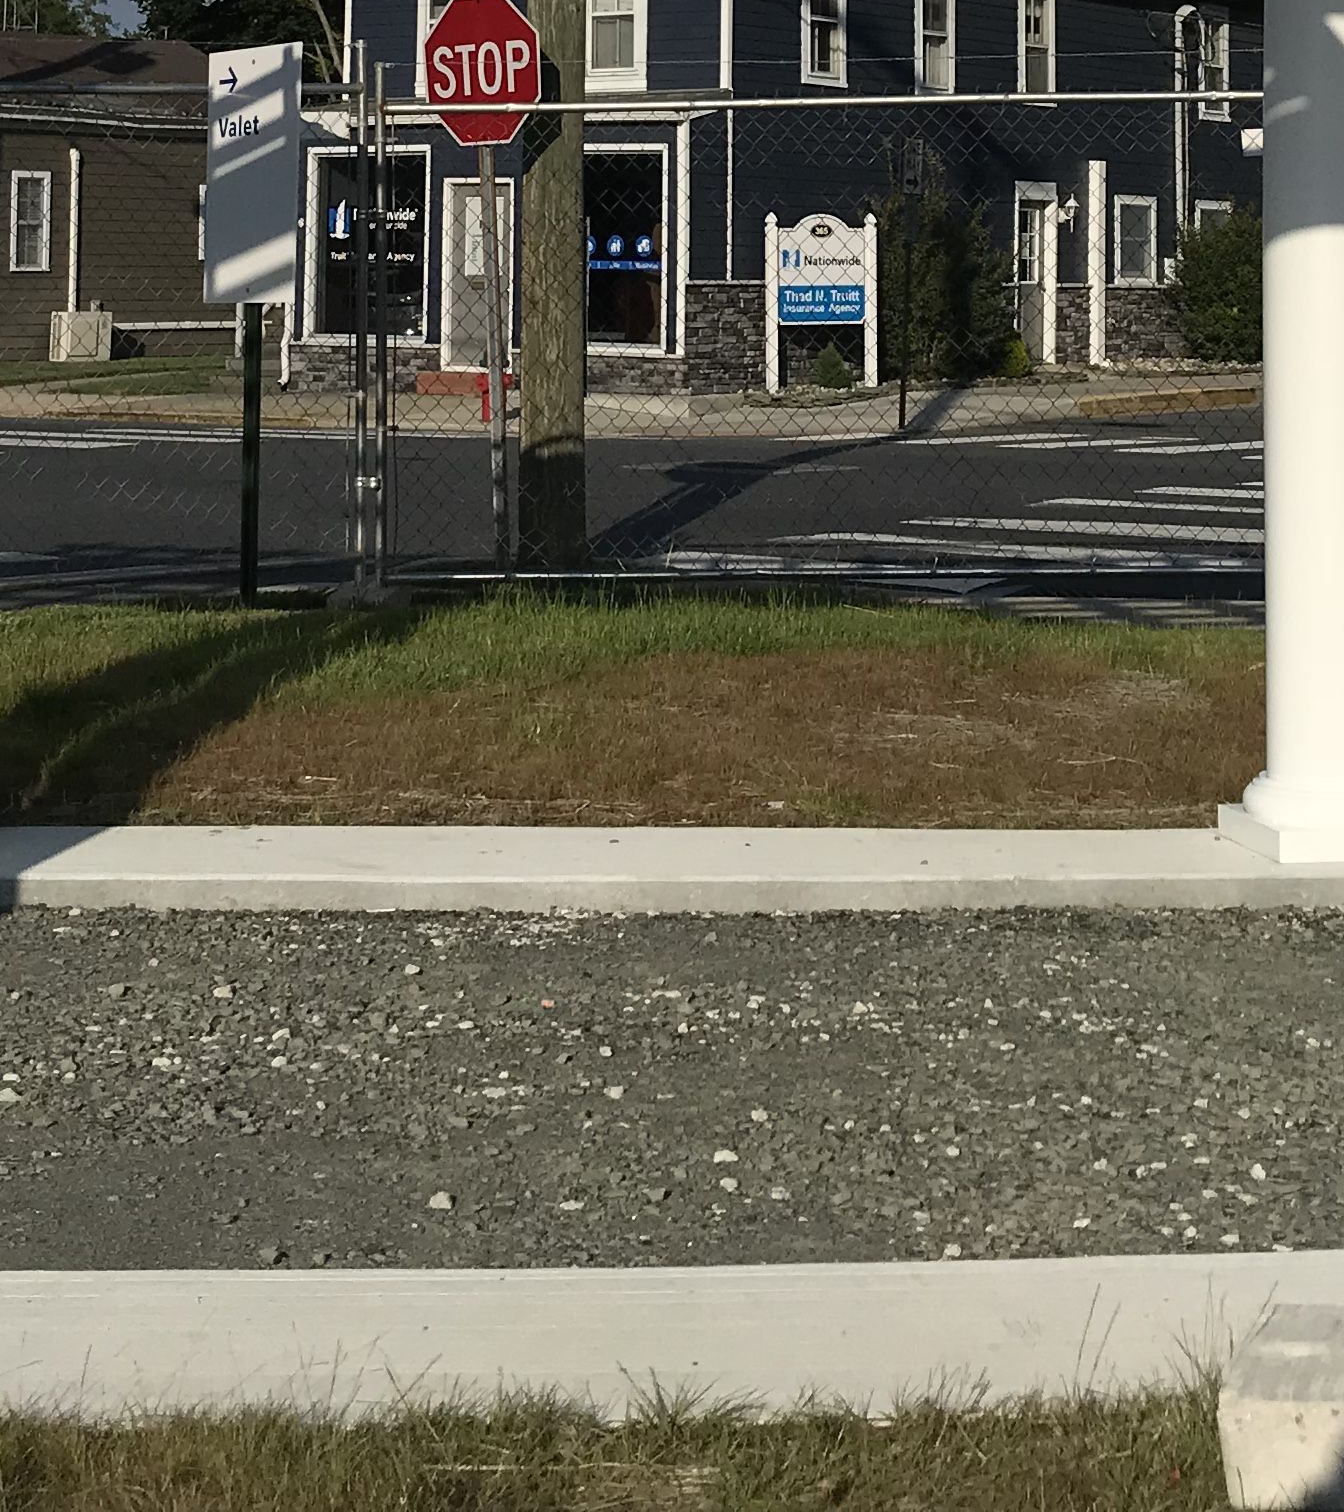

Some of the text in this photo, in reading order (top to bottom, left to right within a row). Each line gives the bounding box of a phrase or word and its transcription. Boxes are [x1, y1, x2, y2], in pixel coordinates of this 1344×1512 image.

[432, 39, 531, 100] STOP
[218, 114, 260, 139] Valet
[814, 226, 829, 236] 365
[804, 255, 862, 266] Nationwide
[783, 289, 813, 302] Thad
[830, 289, 860, 302] Truitt
[783, 303, 861, 315] Insurance Agency
